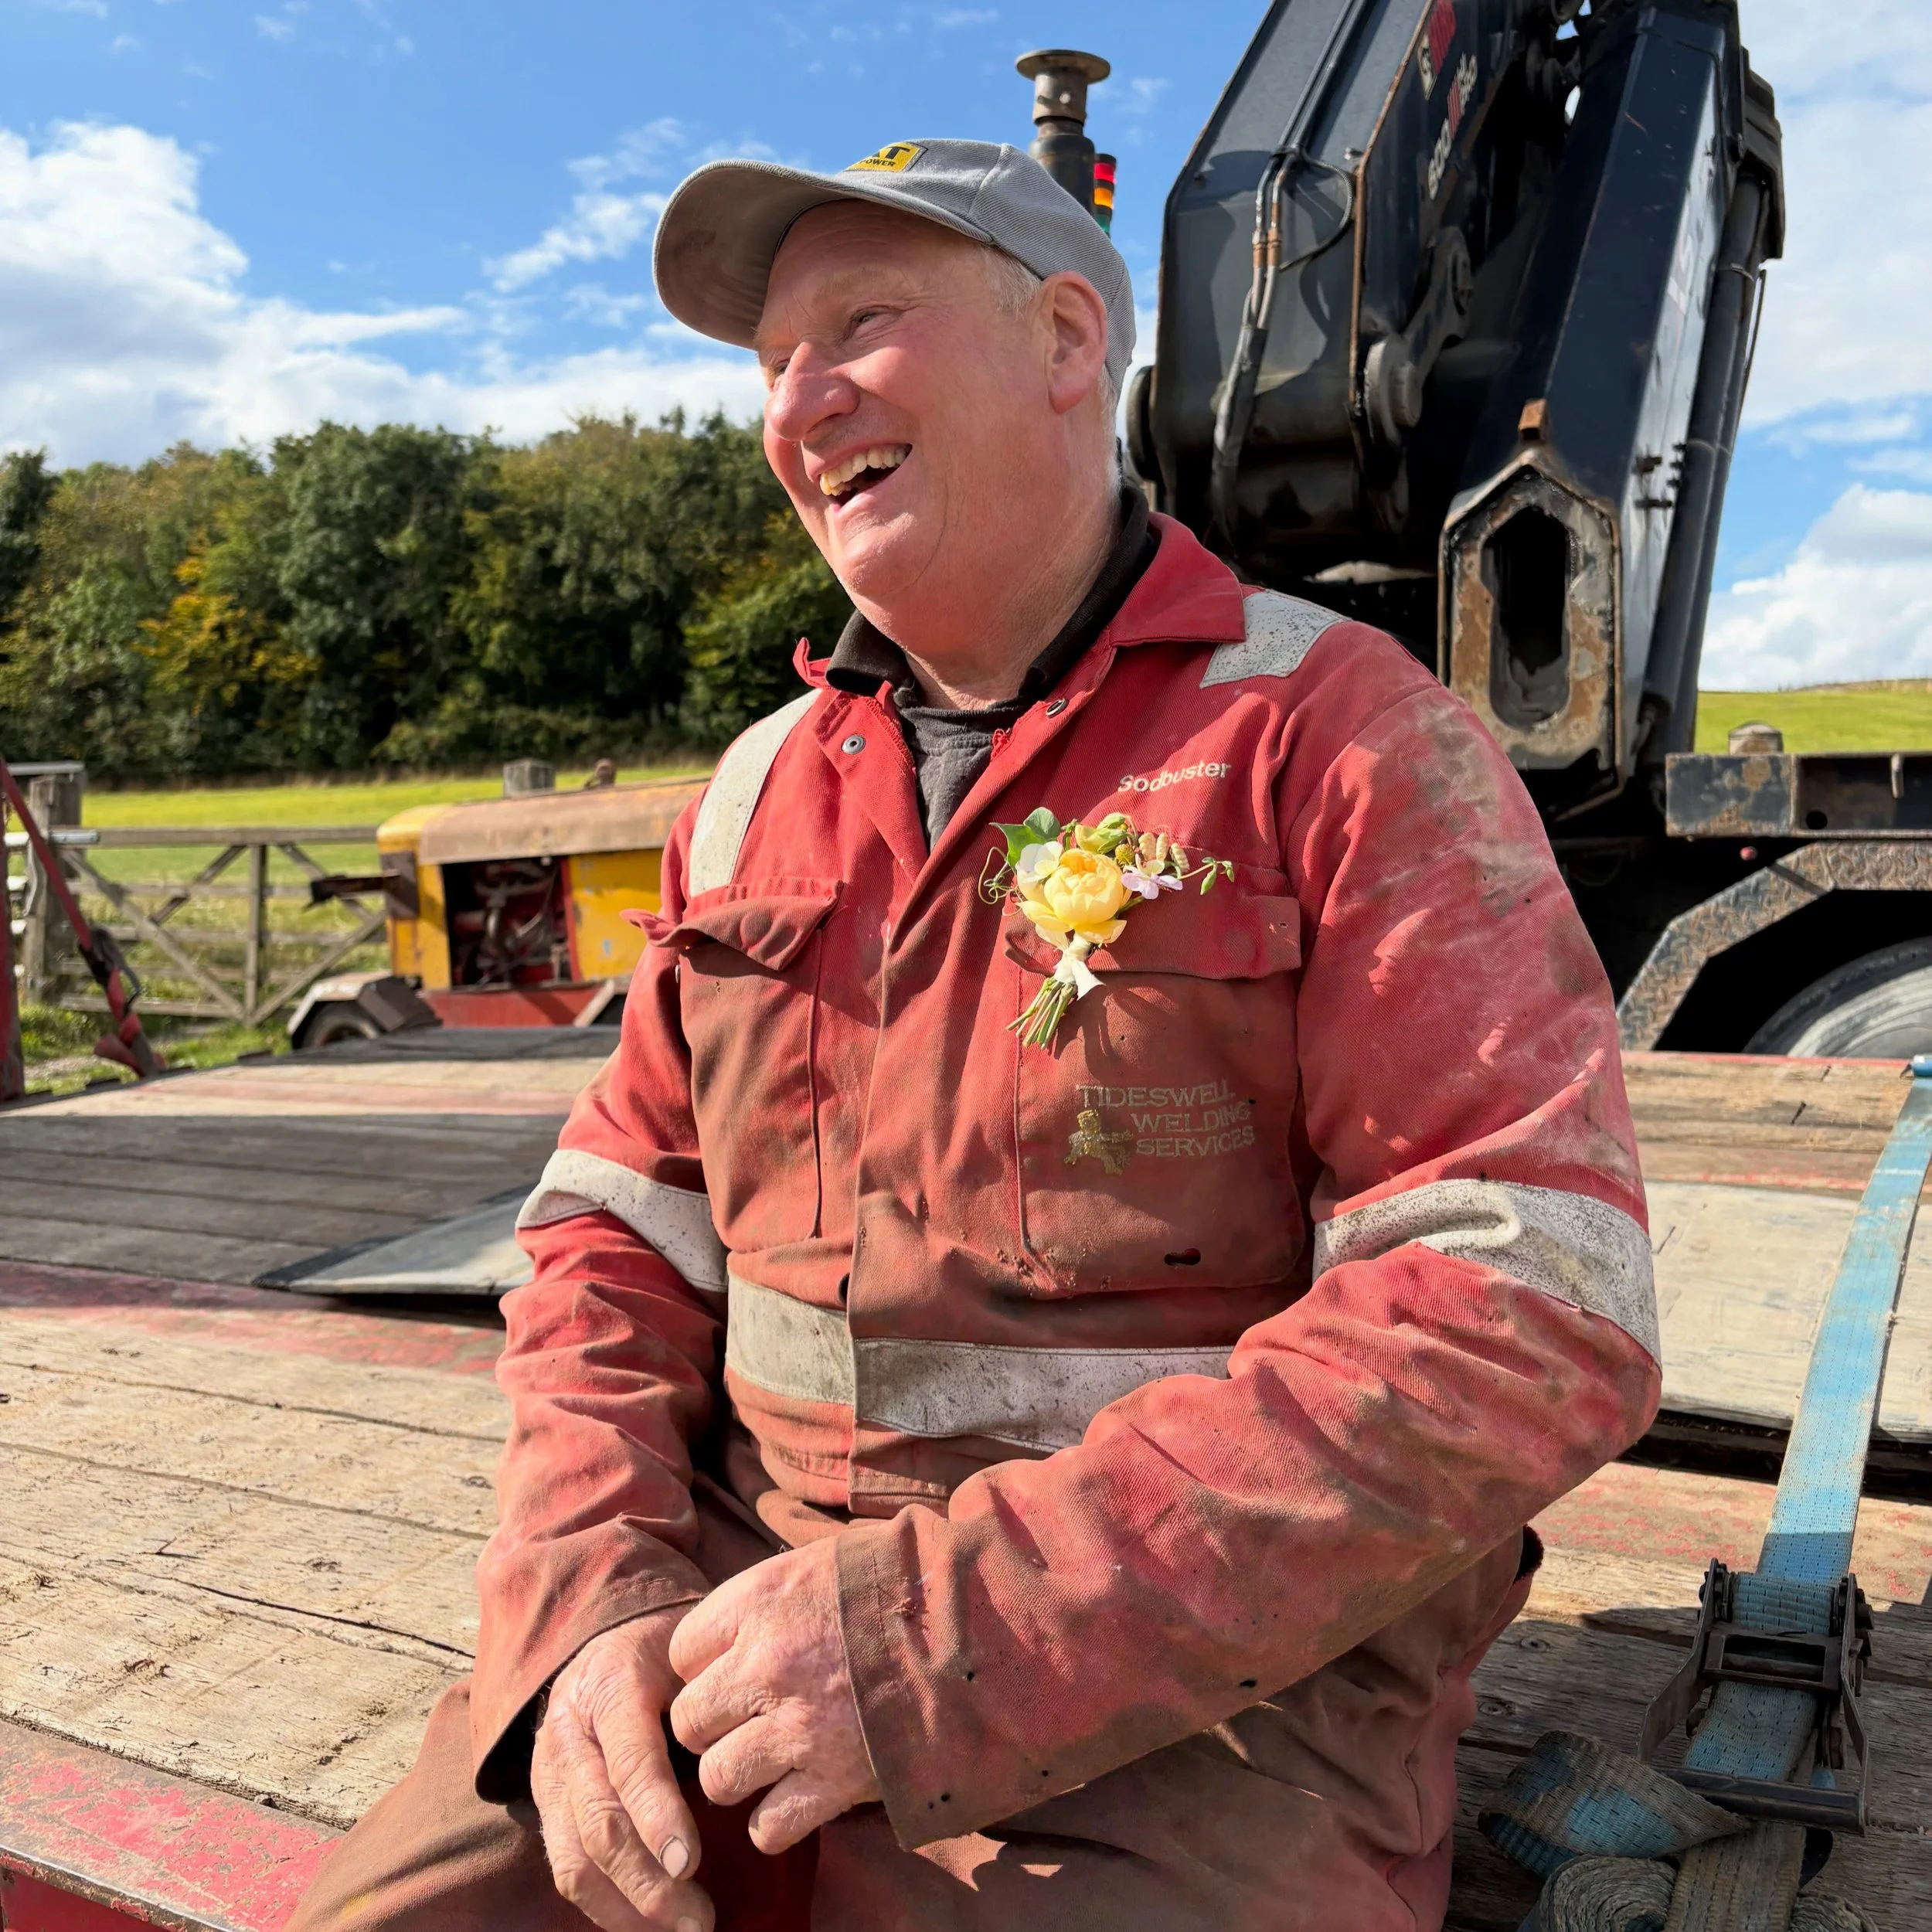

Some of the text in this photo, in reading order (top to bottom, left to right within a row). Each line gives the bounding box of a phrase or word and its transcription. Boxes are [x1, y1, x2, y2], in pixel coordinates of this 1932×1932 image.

[1117, 760, 1231, 792] Sodbuster
[1076, 1079, 1236, 1108] TIDESWELL
[1131, 1101, 1252, 1133] WELDING
[1135, 1125, 1256, 1158] SERVICES
